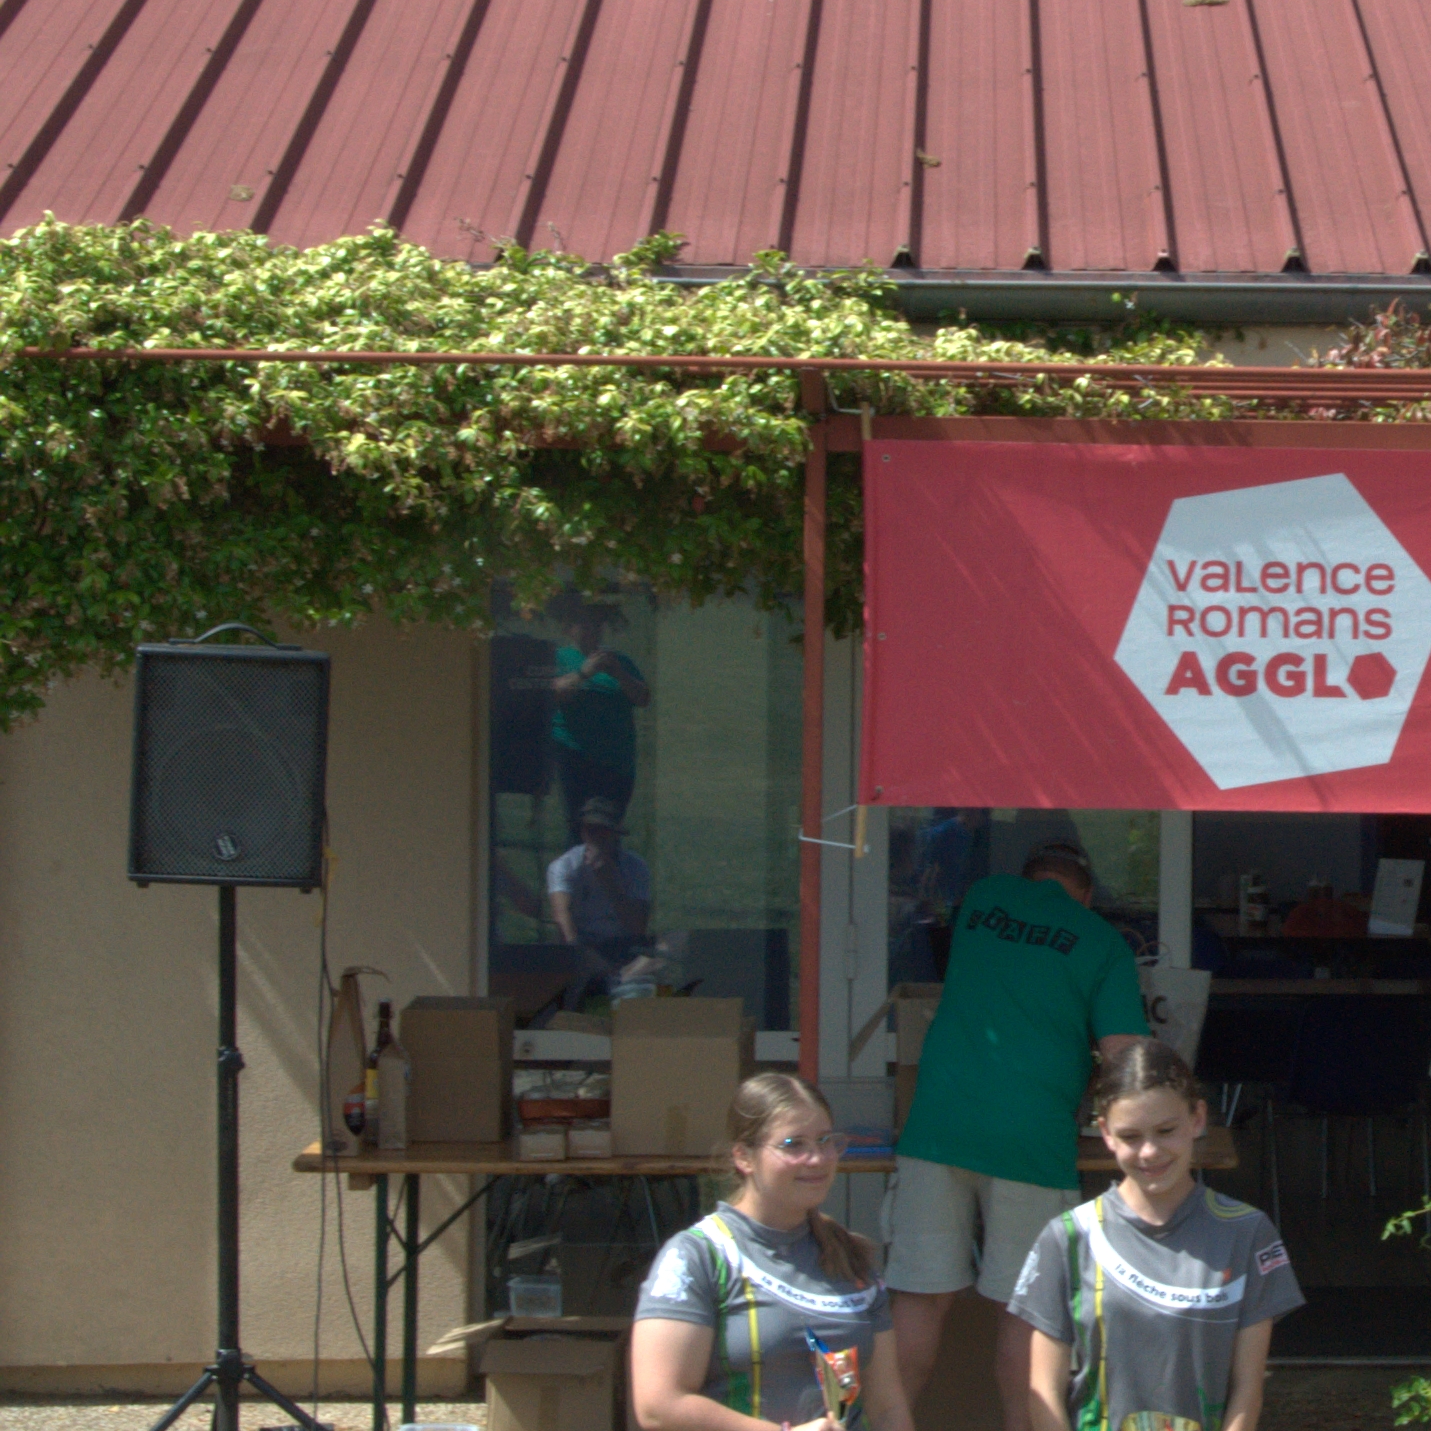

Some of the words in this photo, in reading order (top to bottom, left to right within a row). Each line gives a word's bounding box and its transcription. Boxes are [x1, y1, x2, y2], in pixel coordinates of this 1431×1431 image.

[1166, 603, 1393, 642] Romans
[967, 905, 1080, 956] STAFF
[1171, 1293, 1201, 1303] sous
